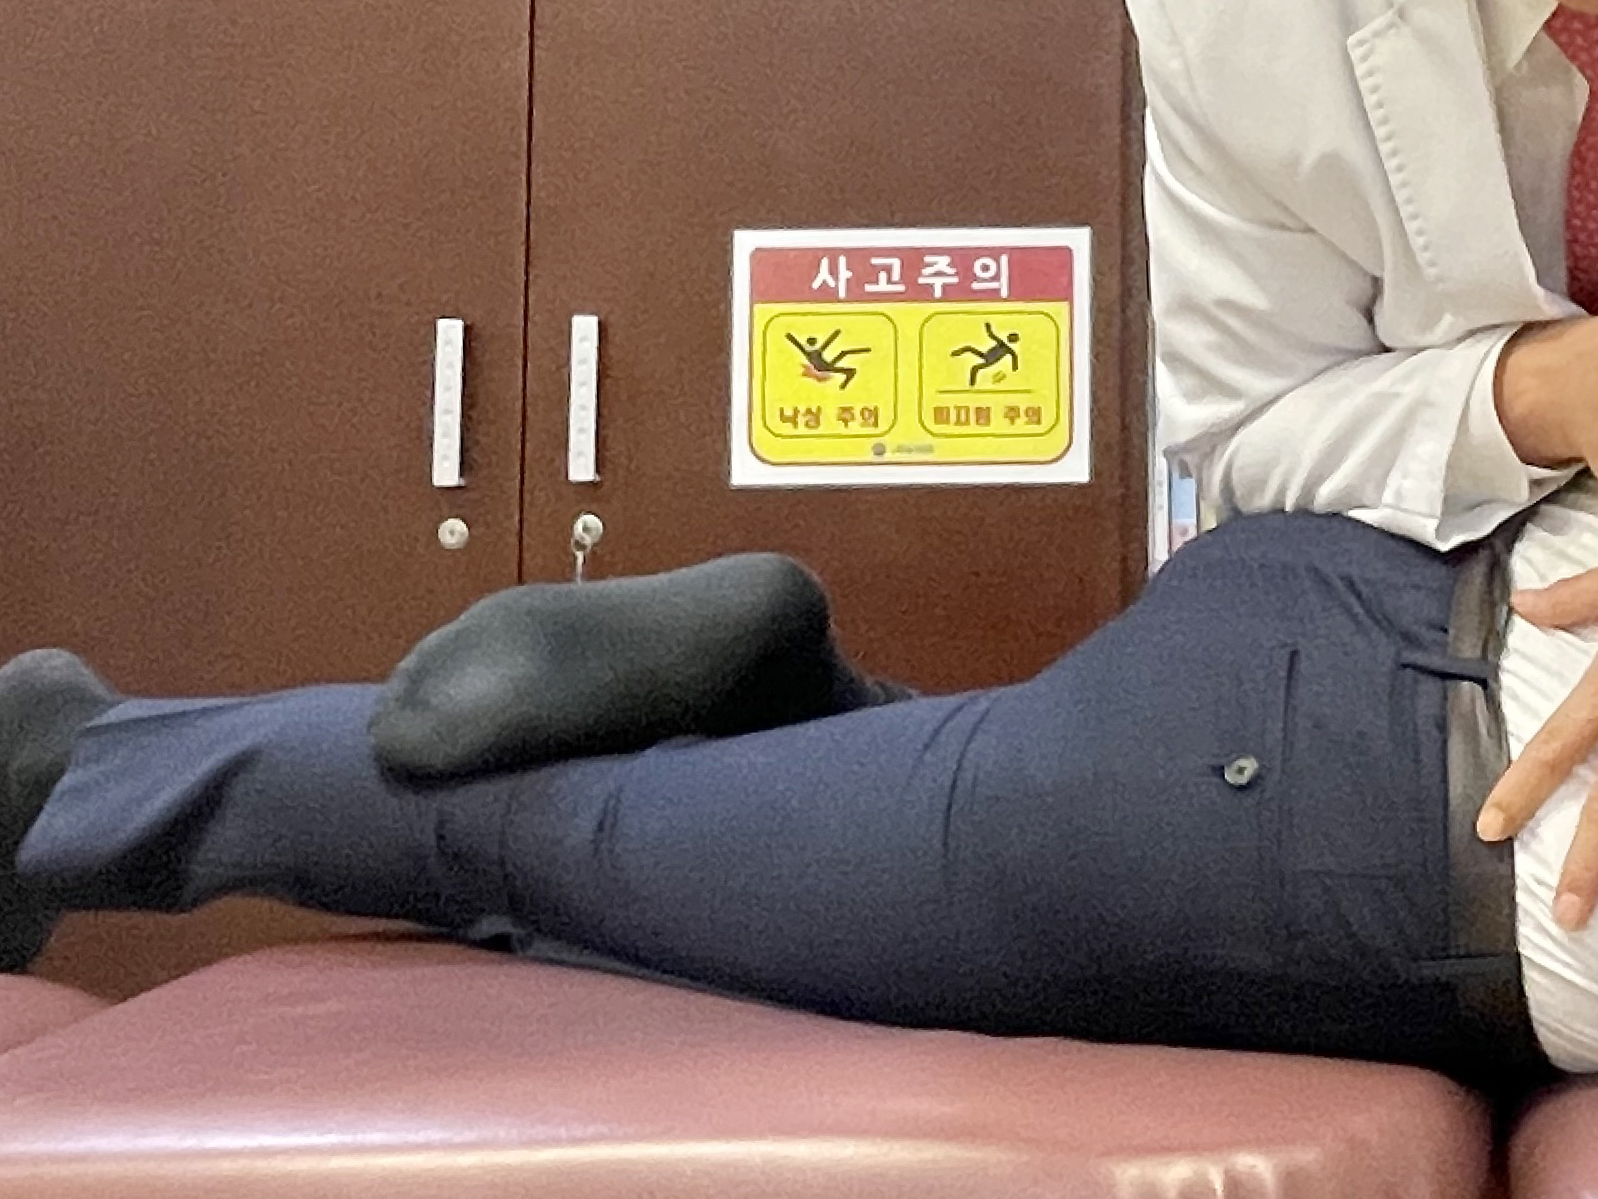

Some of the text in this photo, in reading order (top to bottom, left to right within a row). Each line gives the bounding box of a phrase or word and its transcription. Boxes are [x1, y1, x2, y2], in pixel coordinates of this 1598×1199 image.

[811, 253, 1009, 299] 사고주의
[837, 405, 879, 429] 주의
[1003, 405, 1043, 427] 주의
